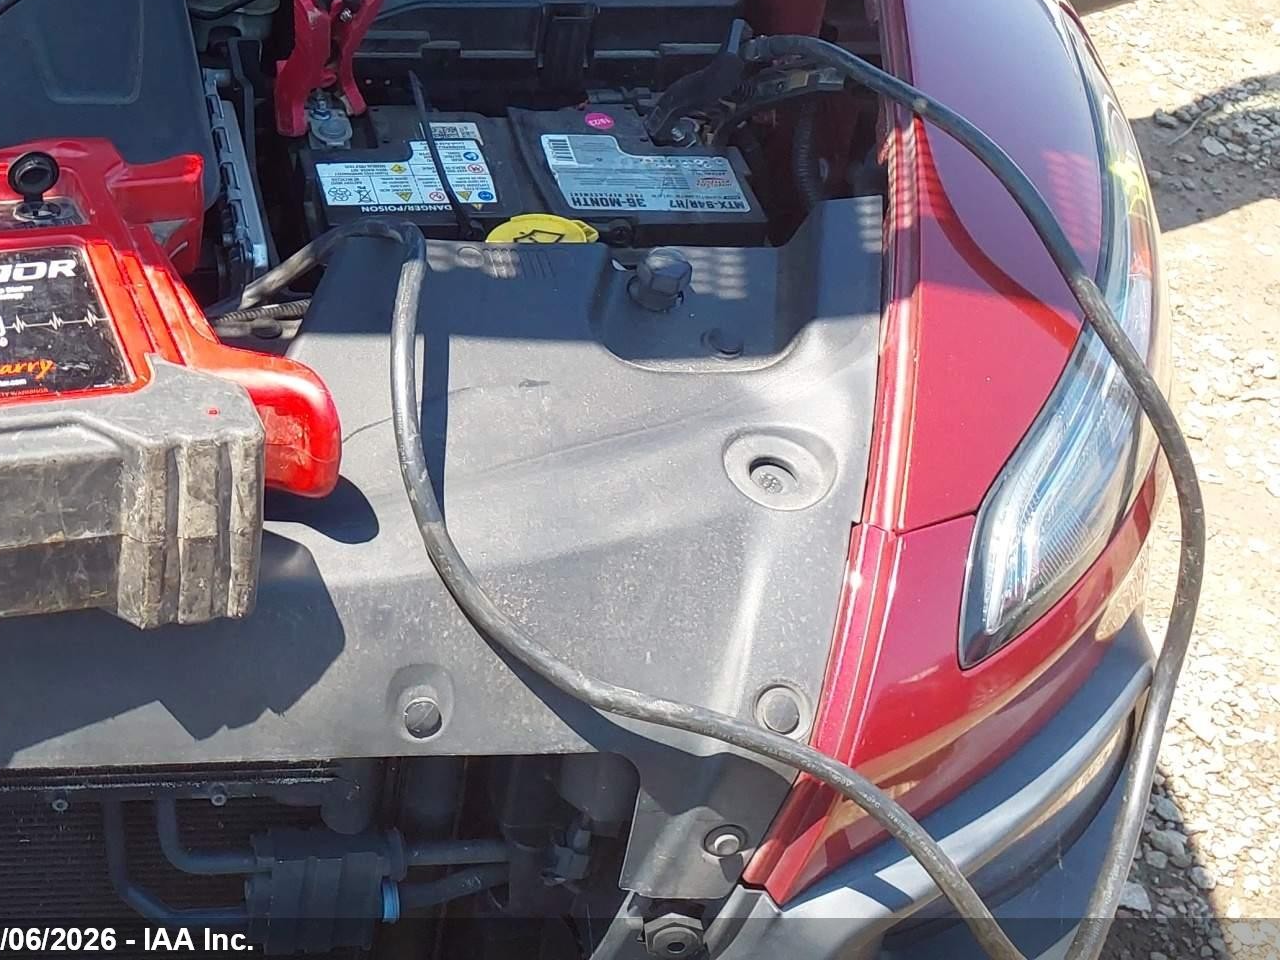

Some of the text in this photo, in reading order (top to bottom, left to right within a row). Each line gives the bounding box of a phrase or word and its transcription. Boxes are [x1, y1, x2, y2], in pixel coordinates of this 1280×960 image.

[572, 196, 648, 208] 36-MONTH
[669, 199, 746, 210] MTX-94R/H7
[360, 205, 454, 214] DANGER/POISON
